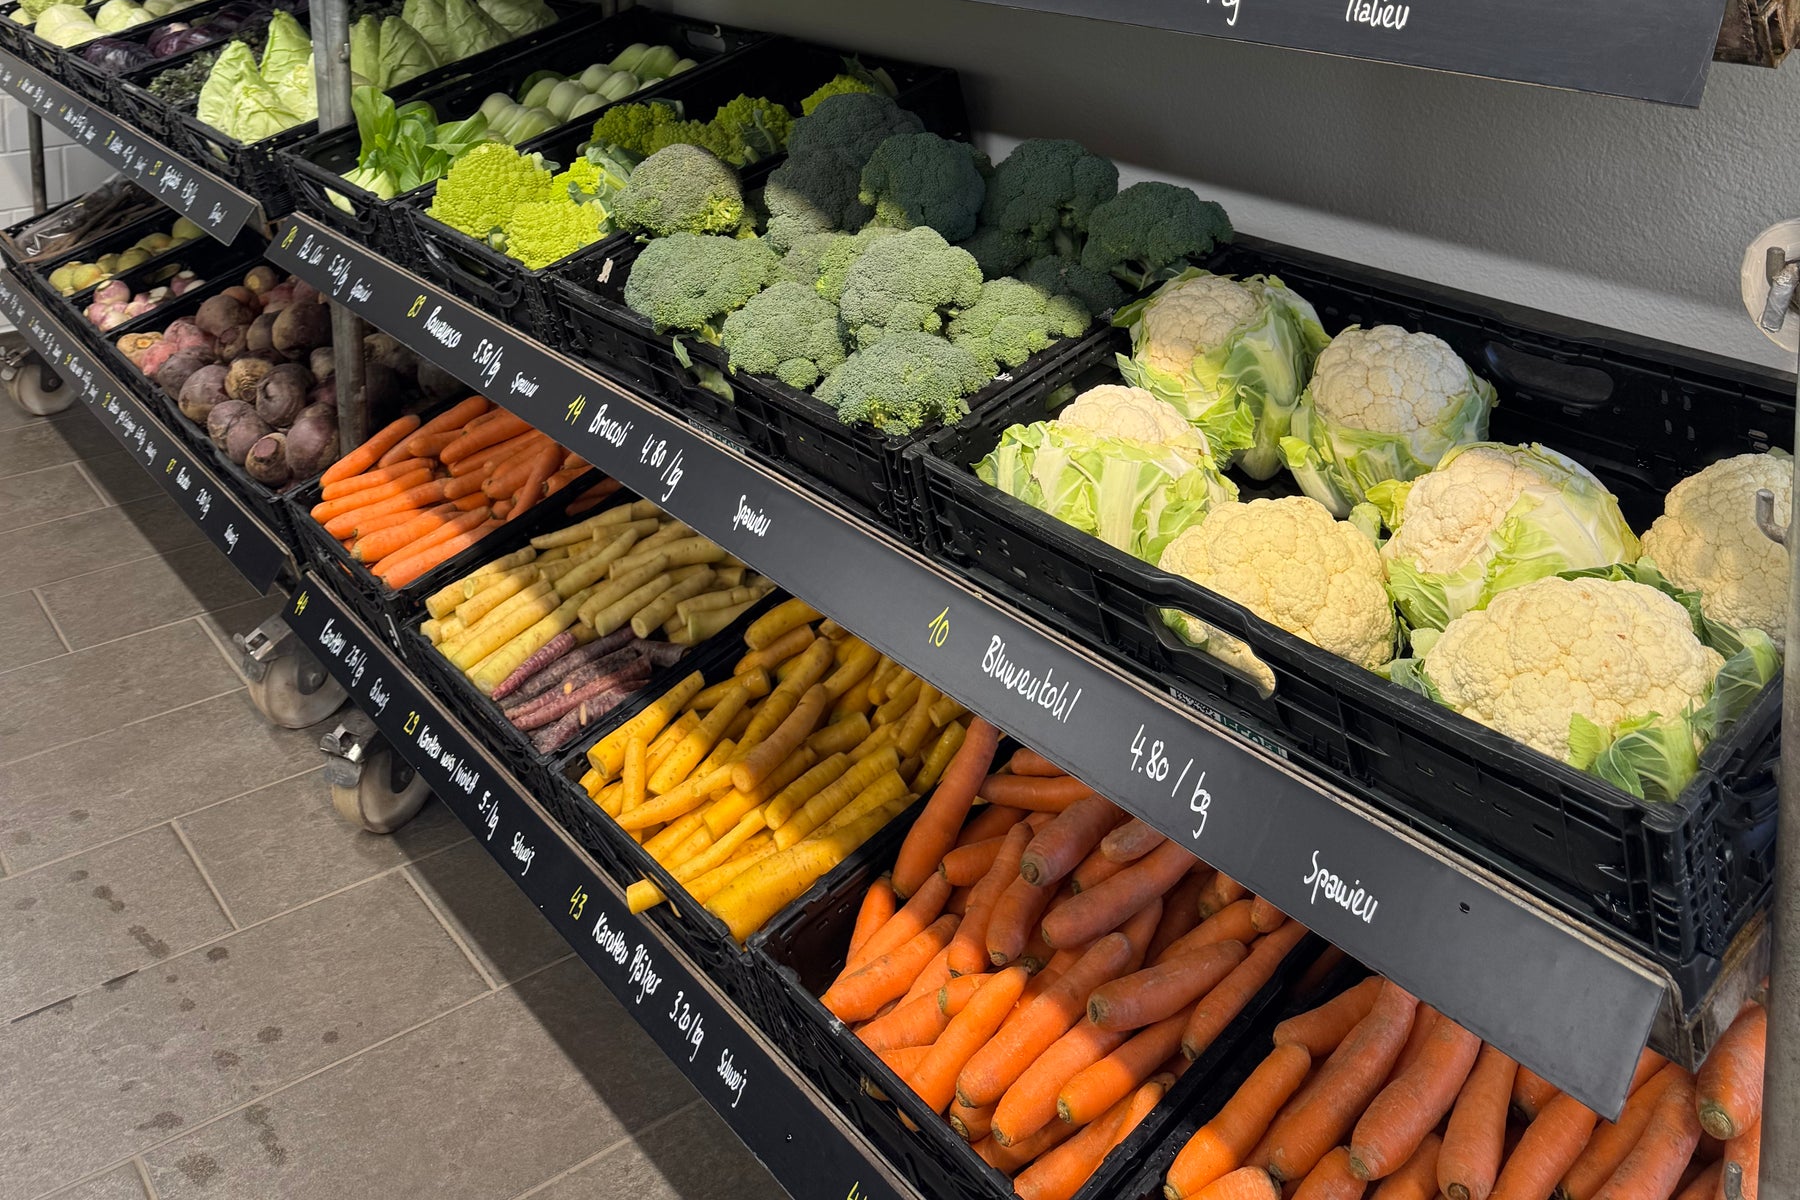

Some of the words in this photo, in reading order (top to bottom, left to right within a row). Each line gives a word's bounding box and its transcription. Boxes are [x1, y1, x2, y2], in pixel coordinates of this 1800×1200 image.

[422, 305, 463, 348] Romanesco
[564, 394, 587, 426] 14
[588, 403, 634, 448] Broccoli
[732, 494, 772, 537] Spanien
[403, 710, 420, 736] 29
[416, 724, 442, 760] Karotten
[511, 831, 536, 877] Schweiz
[927, 605, 951, 649] 10
[981, 633, 1083, 725] Blumenkohl
[1129, 723, 1171, 785] 4.80
[1302, 848, 1380, 925] Spanien
[568, 885, 589, 921] 43
[592, 912, 629, 965] Karotten
[628, 943, 662, 1005] Pfälzer
[716, 1048, 748, 1109] Schweiz
